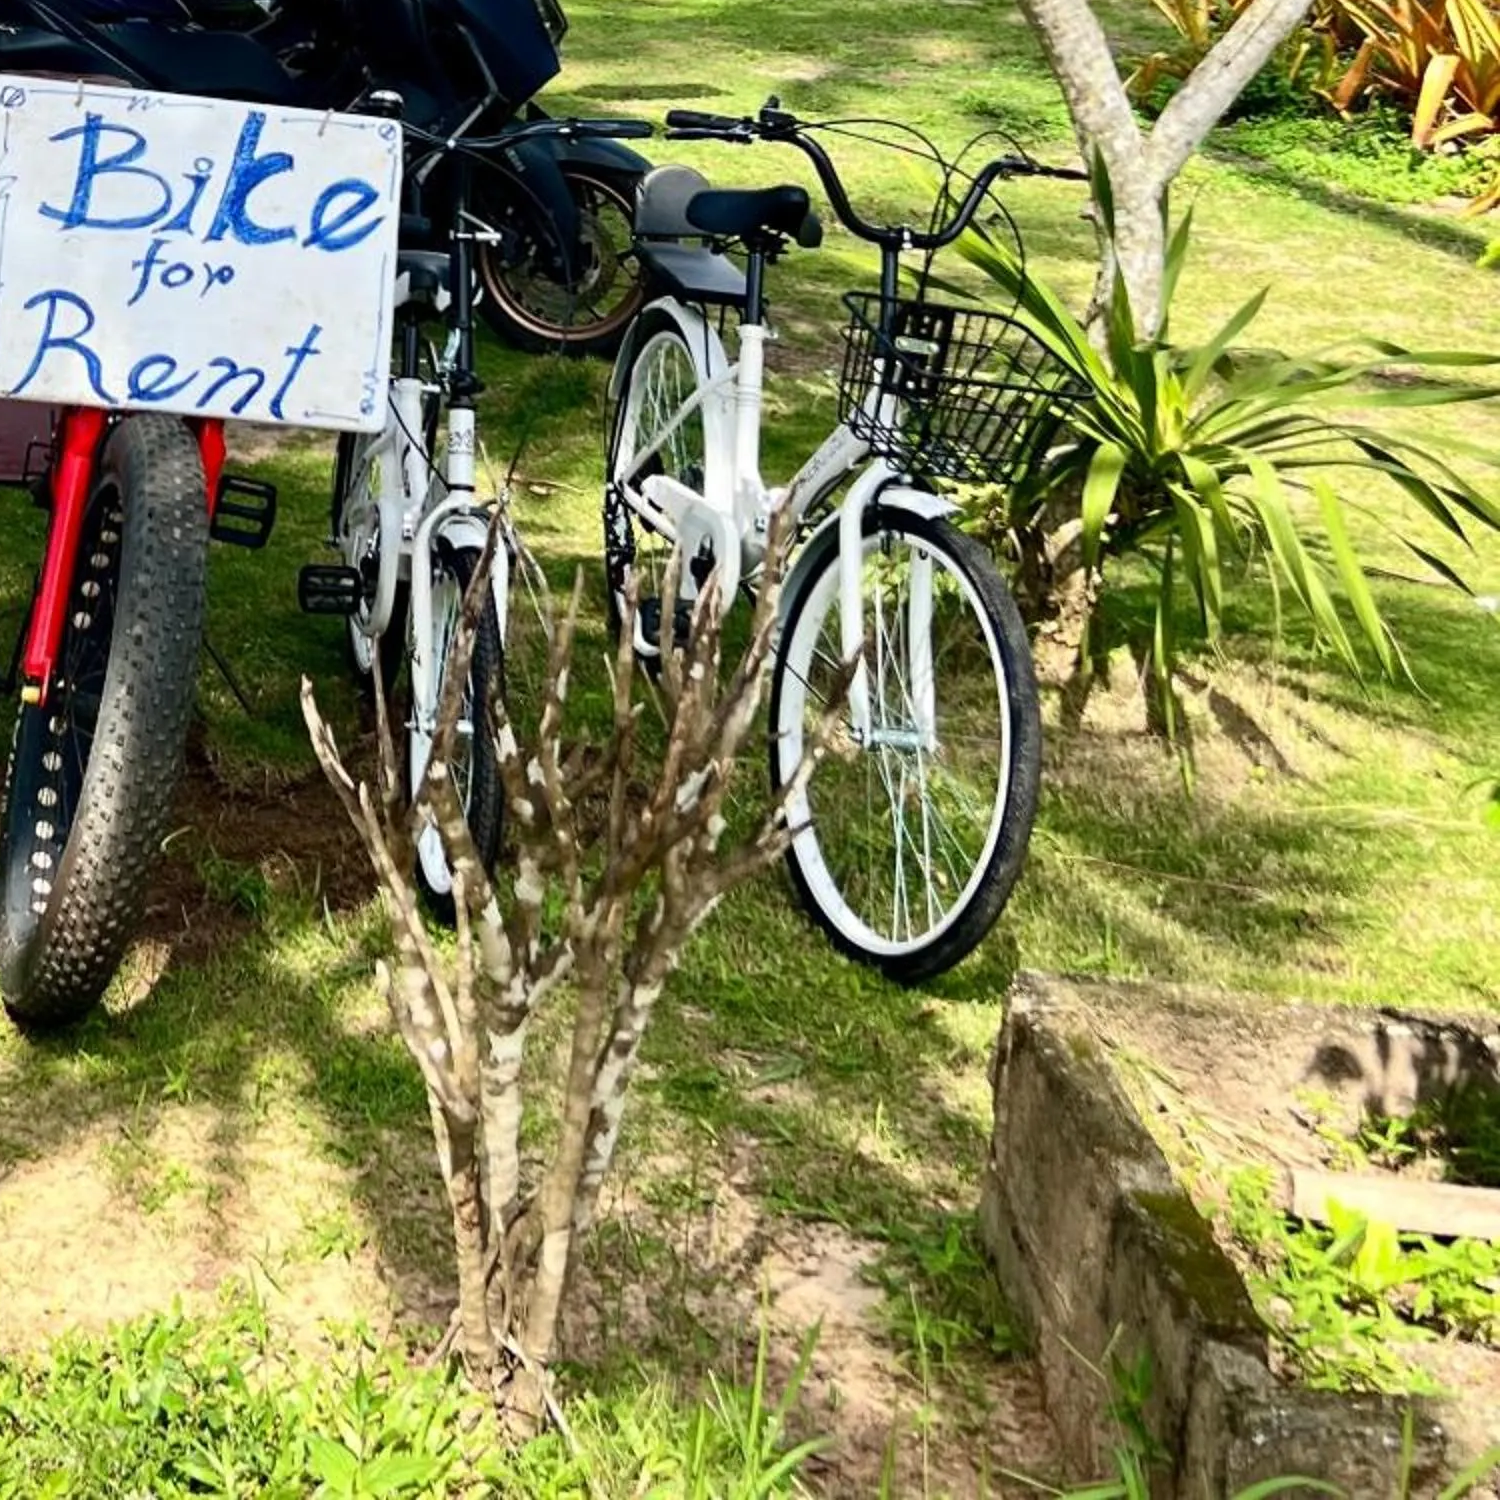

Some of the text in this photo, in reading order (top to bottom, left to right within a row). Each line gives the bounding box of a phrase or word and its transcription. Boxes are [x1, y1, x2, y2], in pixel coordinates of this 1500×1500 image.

[37, 110, 386, 252] Bike
[127, 238, 235, 307] for
[7, 289, 323, 420] Rent
